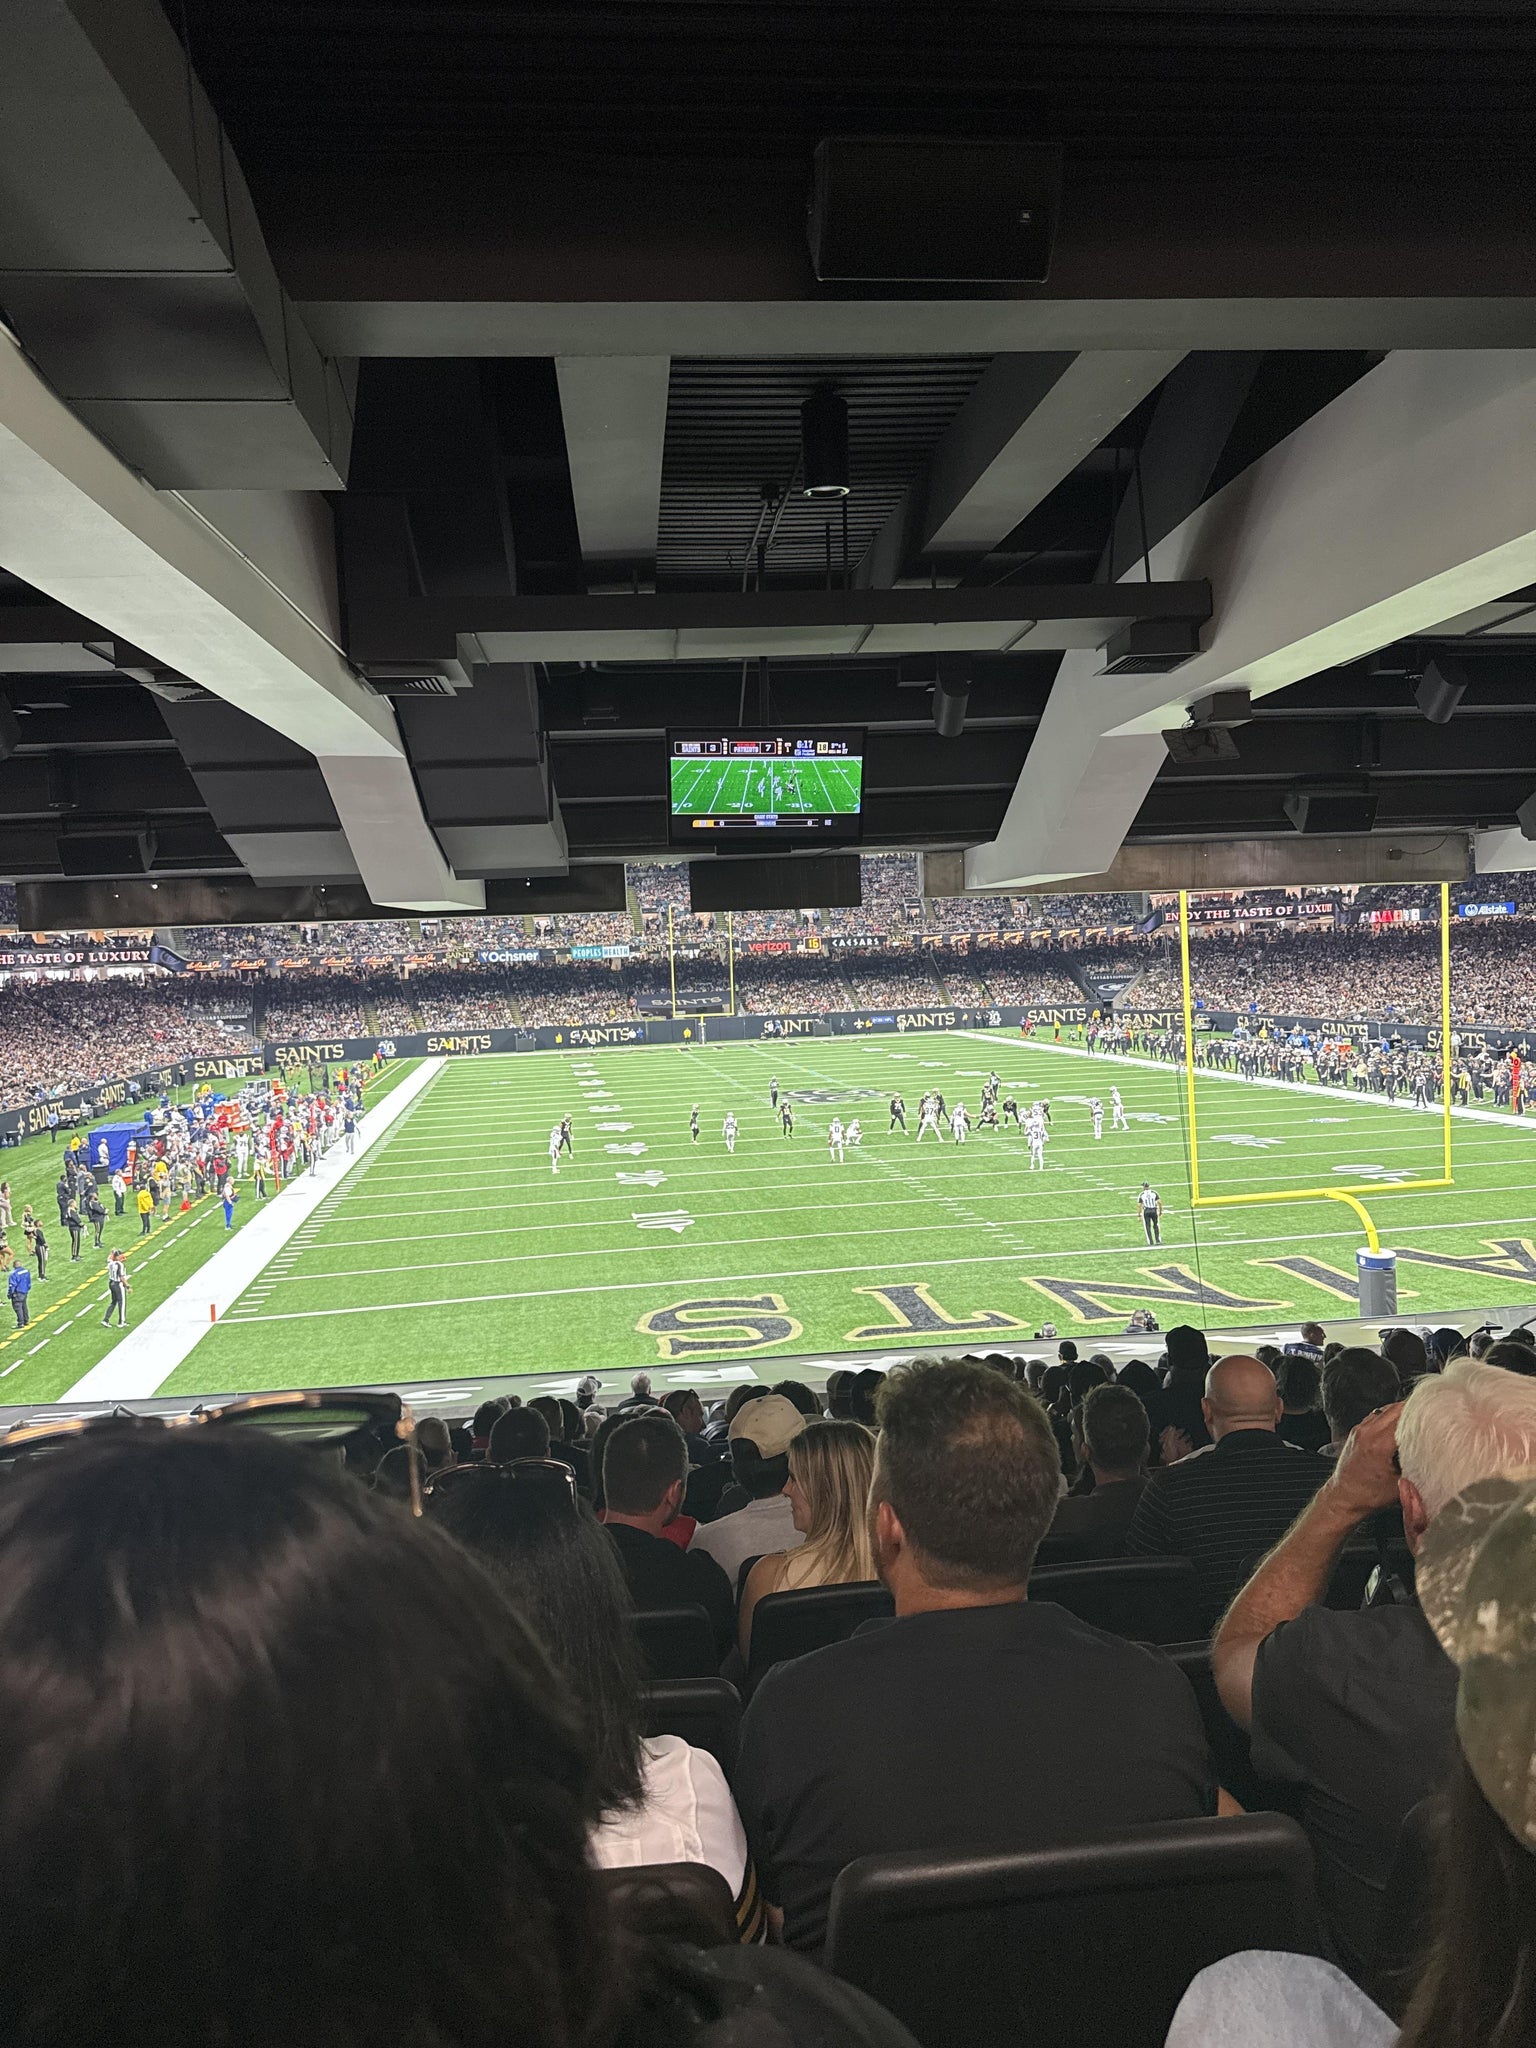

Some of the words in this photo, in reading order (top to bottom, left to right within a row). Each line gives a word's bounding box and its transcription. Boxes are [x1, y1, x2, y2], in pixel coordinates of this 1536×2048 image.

[710, 744, 716, 752] 3
[765, 744, 772, 752] 7
[1165, 911, 1201, 922] ENOY
[1204, 909, 1230, 919] THE
[1233, 907, 1272, 917] TASTE
[1275, 905, 1293, 915] OF
[1477, 904, 1506, 915] Allstate
[639, 944, 667, 952] SAINTS
[700, 942, 726, 950] SAINTS
[748, 941, 791, 951] verizon
[832, 937, 879, 948] CAESARS
[18, 953, 61, 964] TASTE
[64, 952, 84, 963] OF
[89, 951, 150, 962] LUXURY
[445, 951, 475, 959] SAINTS
[488, 950, 538, 962] Ochsner
[573, 948, 601, 957] PEOPLES
[603, 946, 629, 957] HEALTH
[651, 996, 722, 1006] SAINTS
[897, 1012, 956, 1028] SAINTS
[1027, 1007, 1087, 1023] SAINTS
[1122, 1012, 1185, 1029] SAINTS
[570, 1026, 630, 1044] SAINTS
[1321, 1022, 1368, 1037] SAINTS
[275, 1044, 345, 1062] SAINTS
[194, 1056, 263, 1077] SAINTS
[100, 1082, 126, 1101] SAINTS
